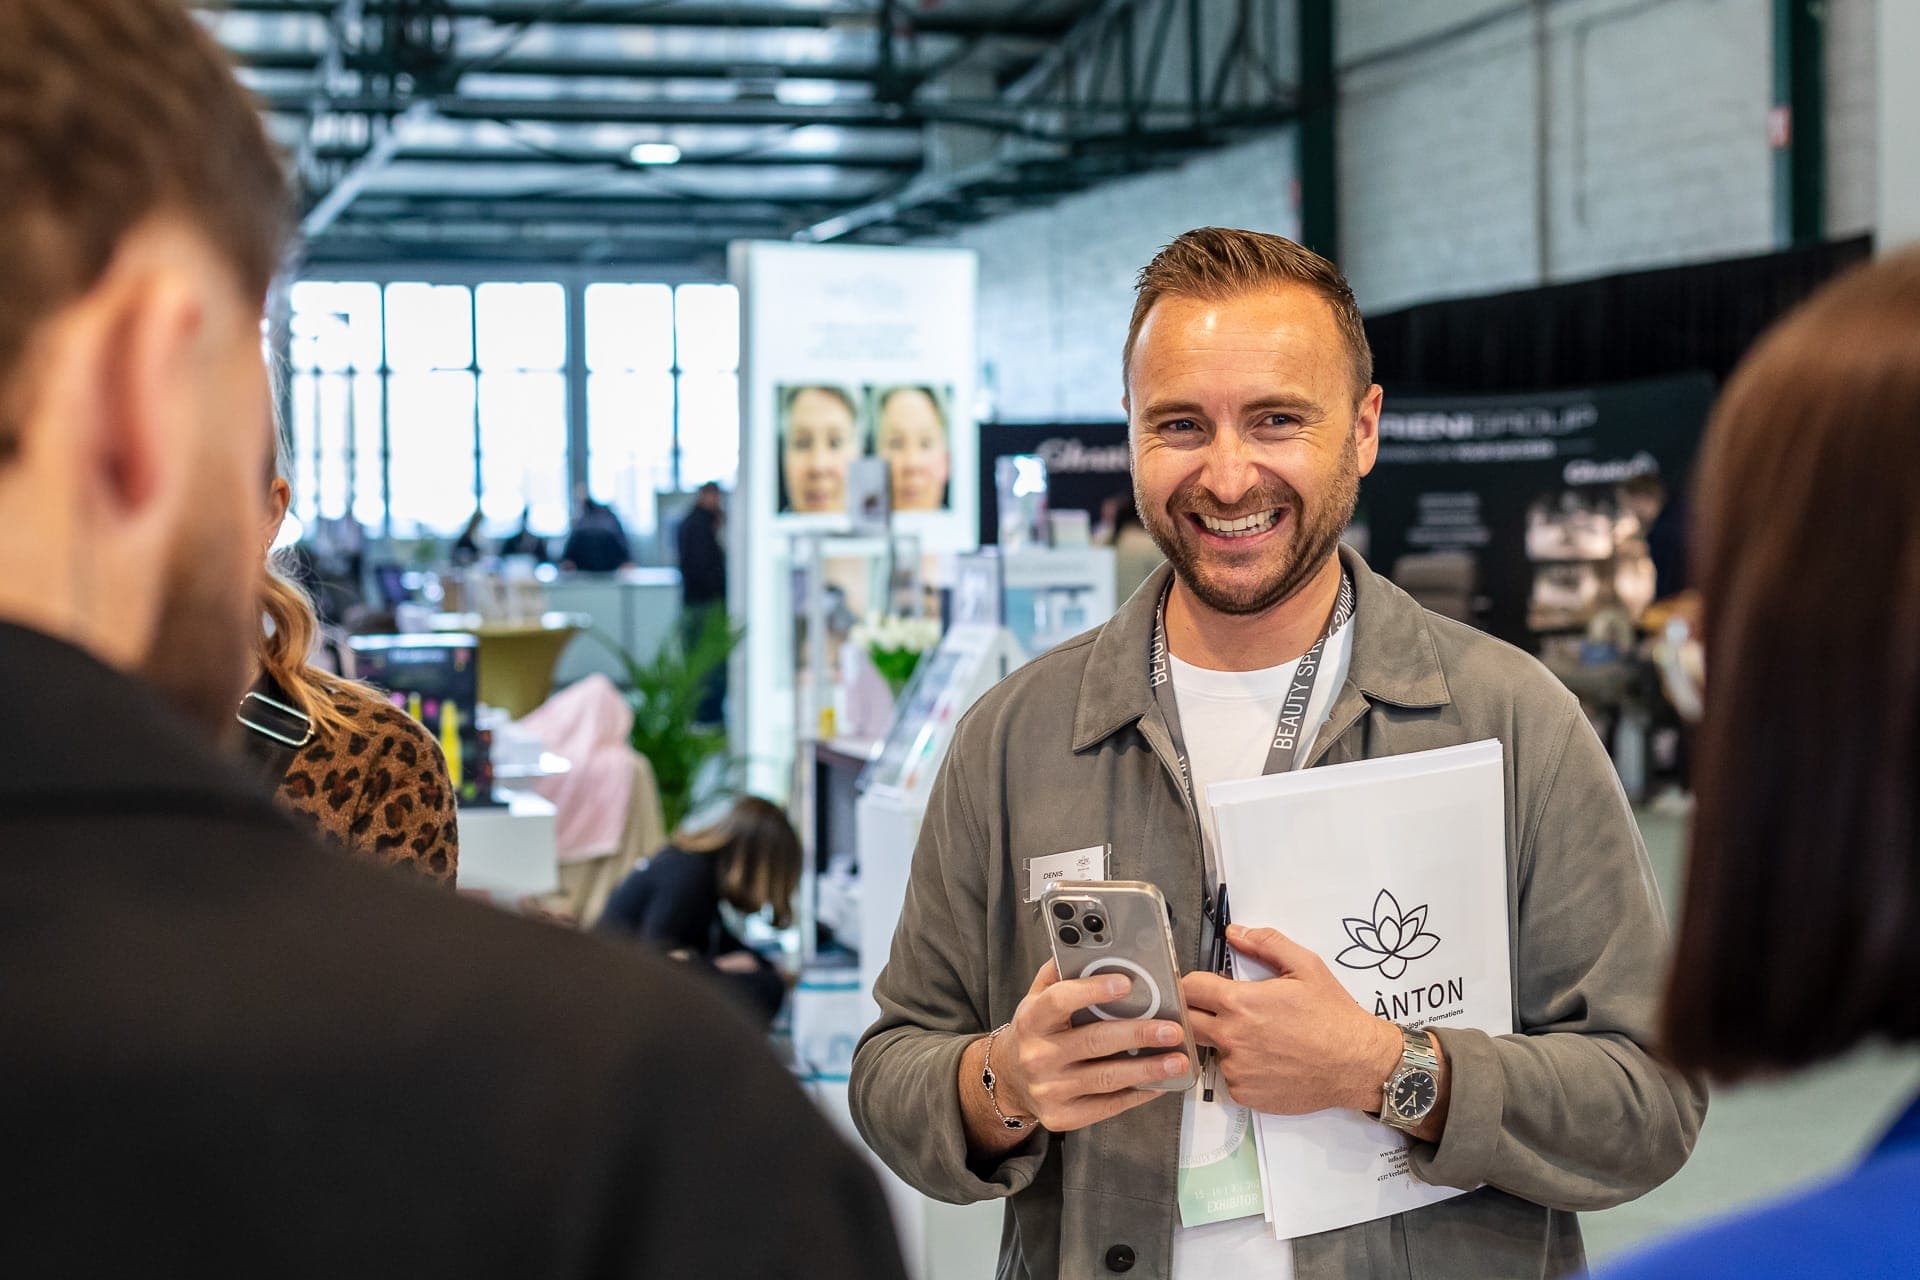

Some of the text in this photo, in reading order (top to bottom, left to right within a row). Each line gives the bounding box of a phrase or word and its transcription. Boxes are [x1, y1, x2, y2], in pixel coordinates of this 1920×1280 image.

[1273, 681, 1310, 750] BEAUTY
[1043, 870, 1064, 880] DENIS
[1374, 976, 1463, 1021] ÀNTON
[1428, 1008, 1464, 1023] Formations
[1207, 1193, 1258, 1214] EXHIBITOR
